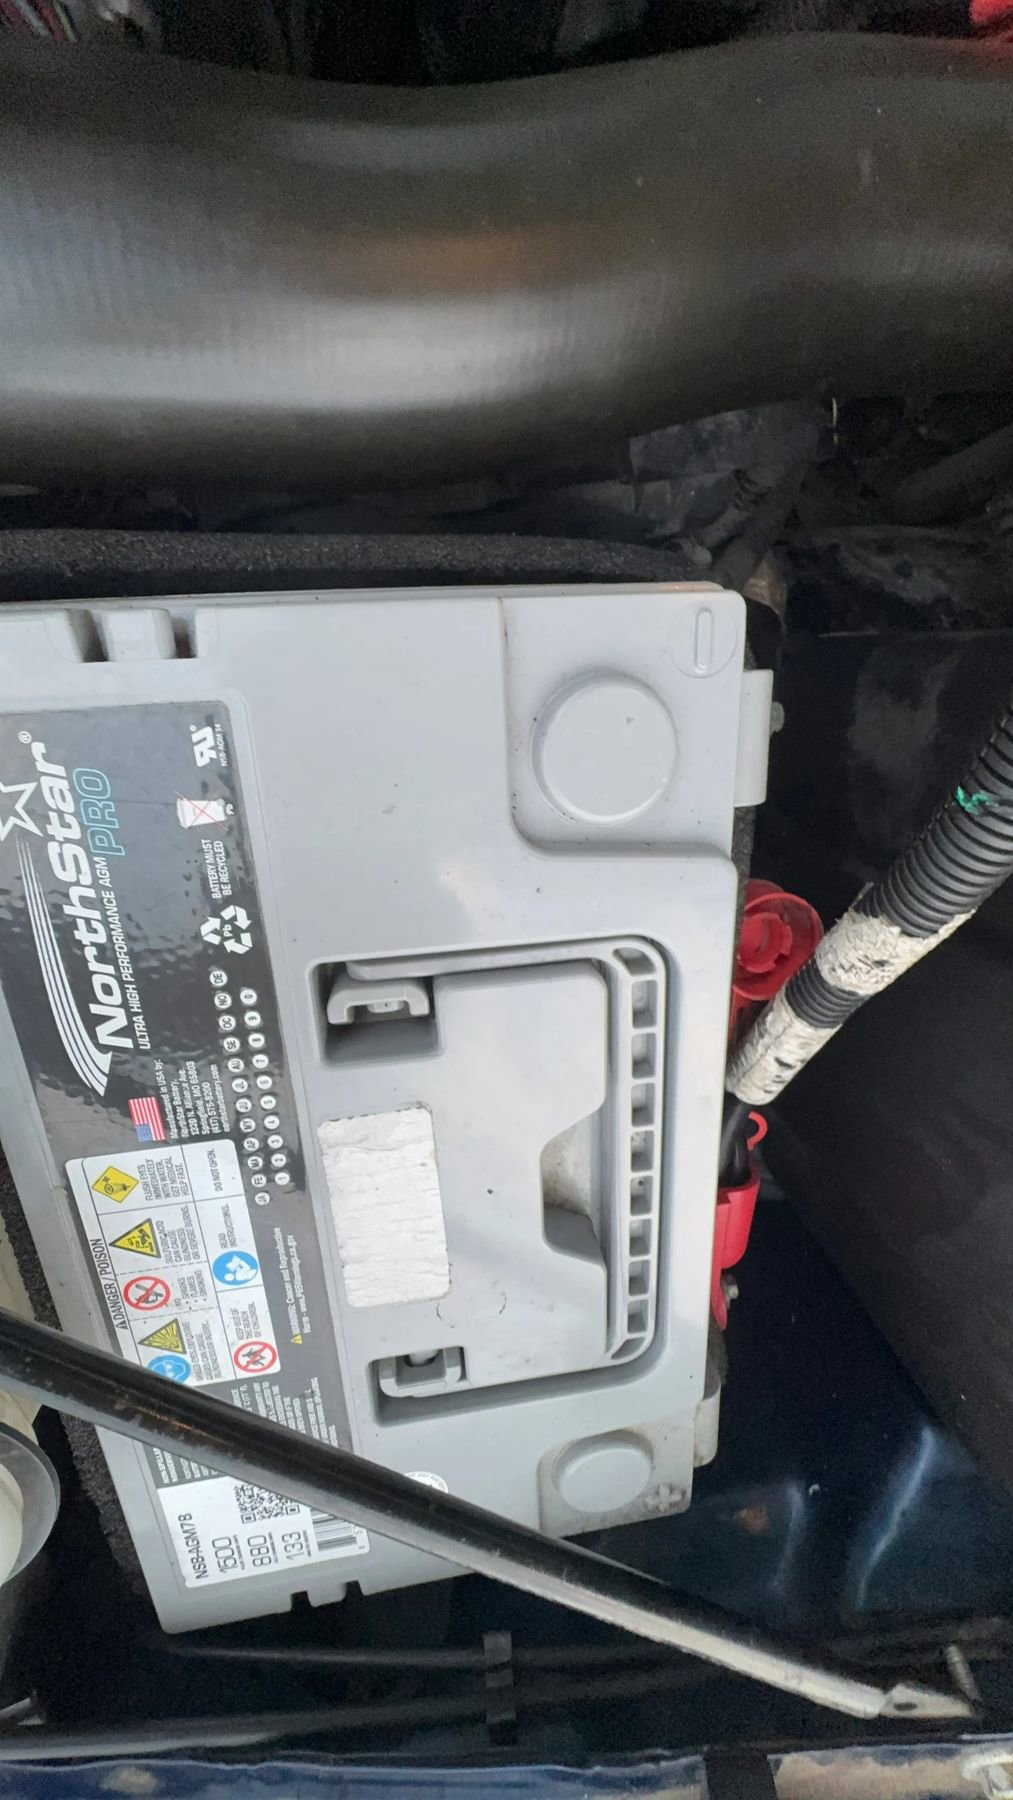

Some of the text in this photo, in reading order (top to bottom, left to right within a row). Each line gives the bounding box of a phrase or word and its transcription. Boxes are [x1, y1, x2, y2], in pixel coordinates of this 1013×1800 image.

[71, 768, 124, 855] PRO
[201, 839, 221, 897] BATTERY MUST
[213, 840, 231, 894] BE RECYCLED
[29, 742, 133, 1047] NorthStar
[222, 923, 232, 937] Pb
[93, 857, 150, 1048] ULTRA HIGH PERFORMANCE AGM
[155, 1070, 165, 1085] USA
[185, 1060, 198, 1084] 65803
[191, 1084, 201, 1097] MO
[174, 1105, 188, 1137] NorthStar
[187, 1118, 199, 1135] 1320
[209, 1116, 221, 1133] (417)
[137, 1164, 152, 1200] FLUSH EYES
[145, 1158, 161, 1199] IMMEDIATELY
[161, 1183, 170, 1198] WITH
[164, 1156, 179, 1197] GET MEDICAL
[179, 1180, 189, 1195] HELP
[210, 1168, 220, 1181] NOT
[213, 1182, 222, 1191] DO
[90, 1237, 112, 1275] POISON
[167, 1229, 182, 1262] CAN CAUSE
[104, 1282, 124, 1320] DANGER
[178, 1513, 208, 1578] NSB-AGM78
[211, 1536, 238, 1573] 1500
[247, 1534, 271, 1566] 880
[281, 1531, 304, 1560] 133
